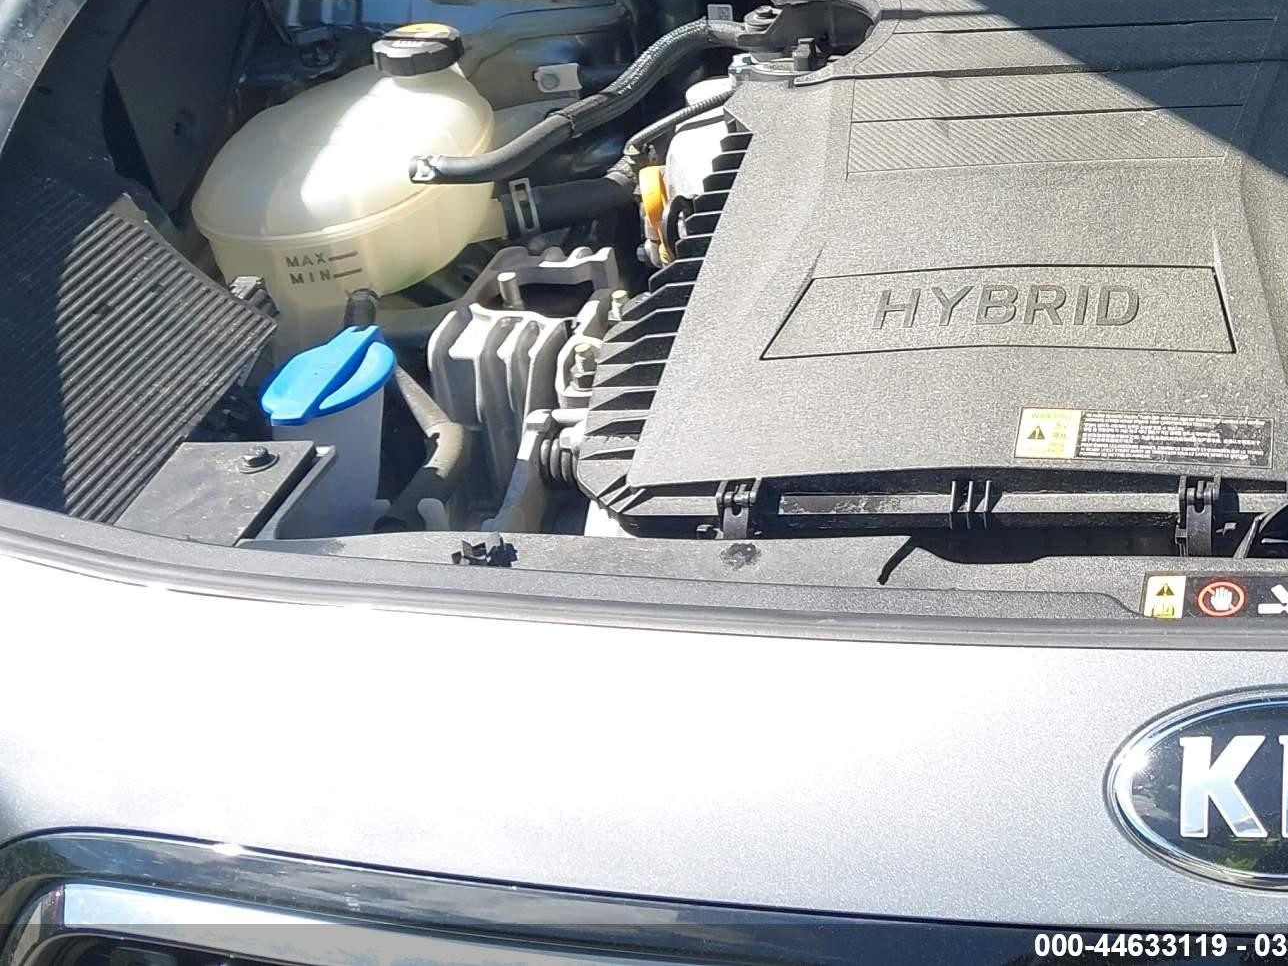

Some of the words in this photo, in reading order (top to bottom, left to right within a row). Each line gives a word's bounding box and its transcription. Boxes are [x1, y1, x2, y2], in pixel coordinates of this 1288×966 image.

[285, 252, 327, 267] MAX
[289, 269, 331, 285] MIN
[872, 284, 1139, 330] HYBRID
